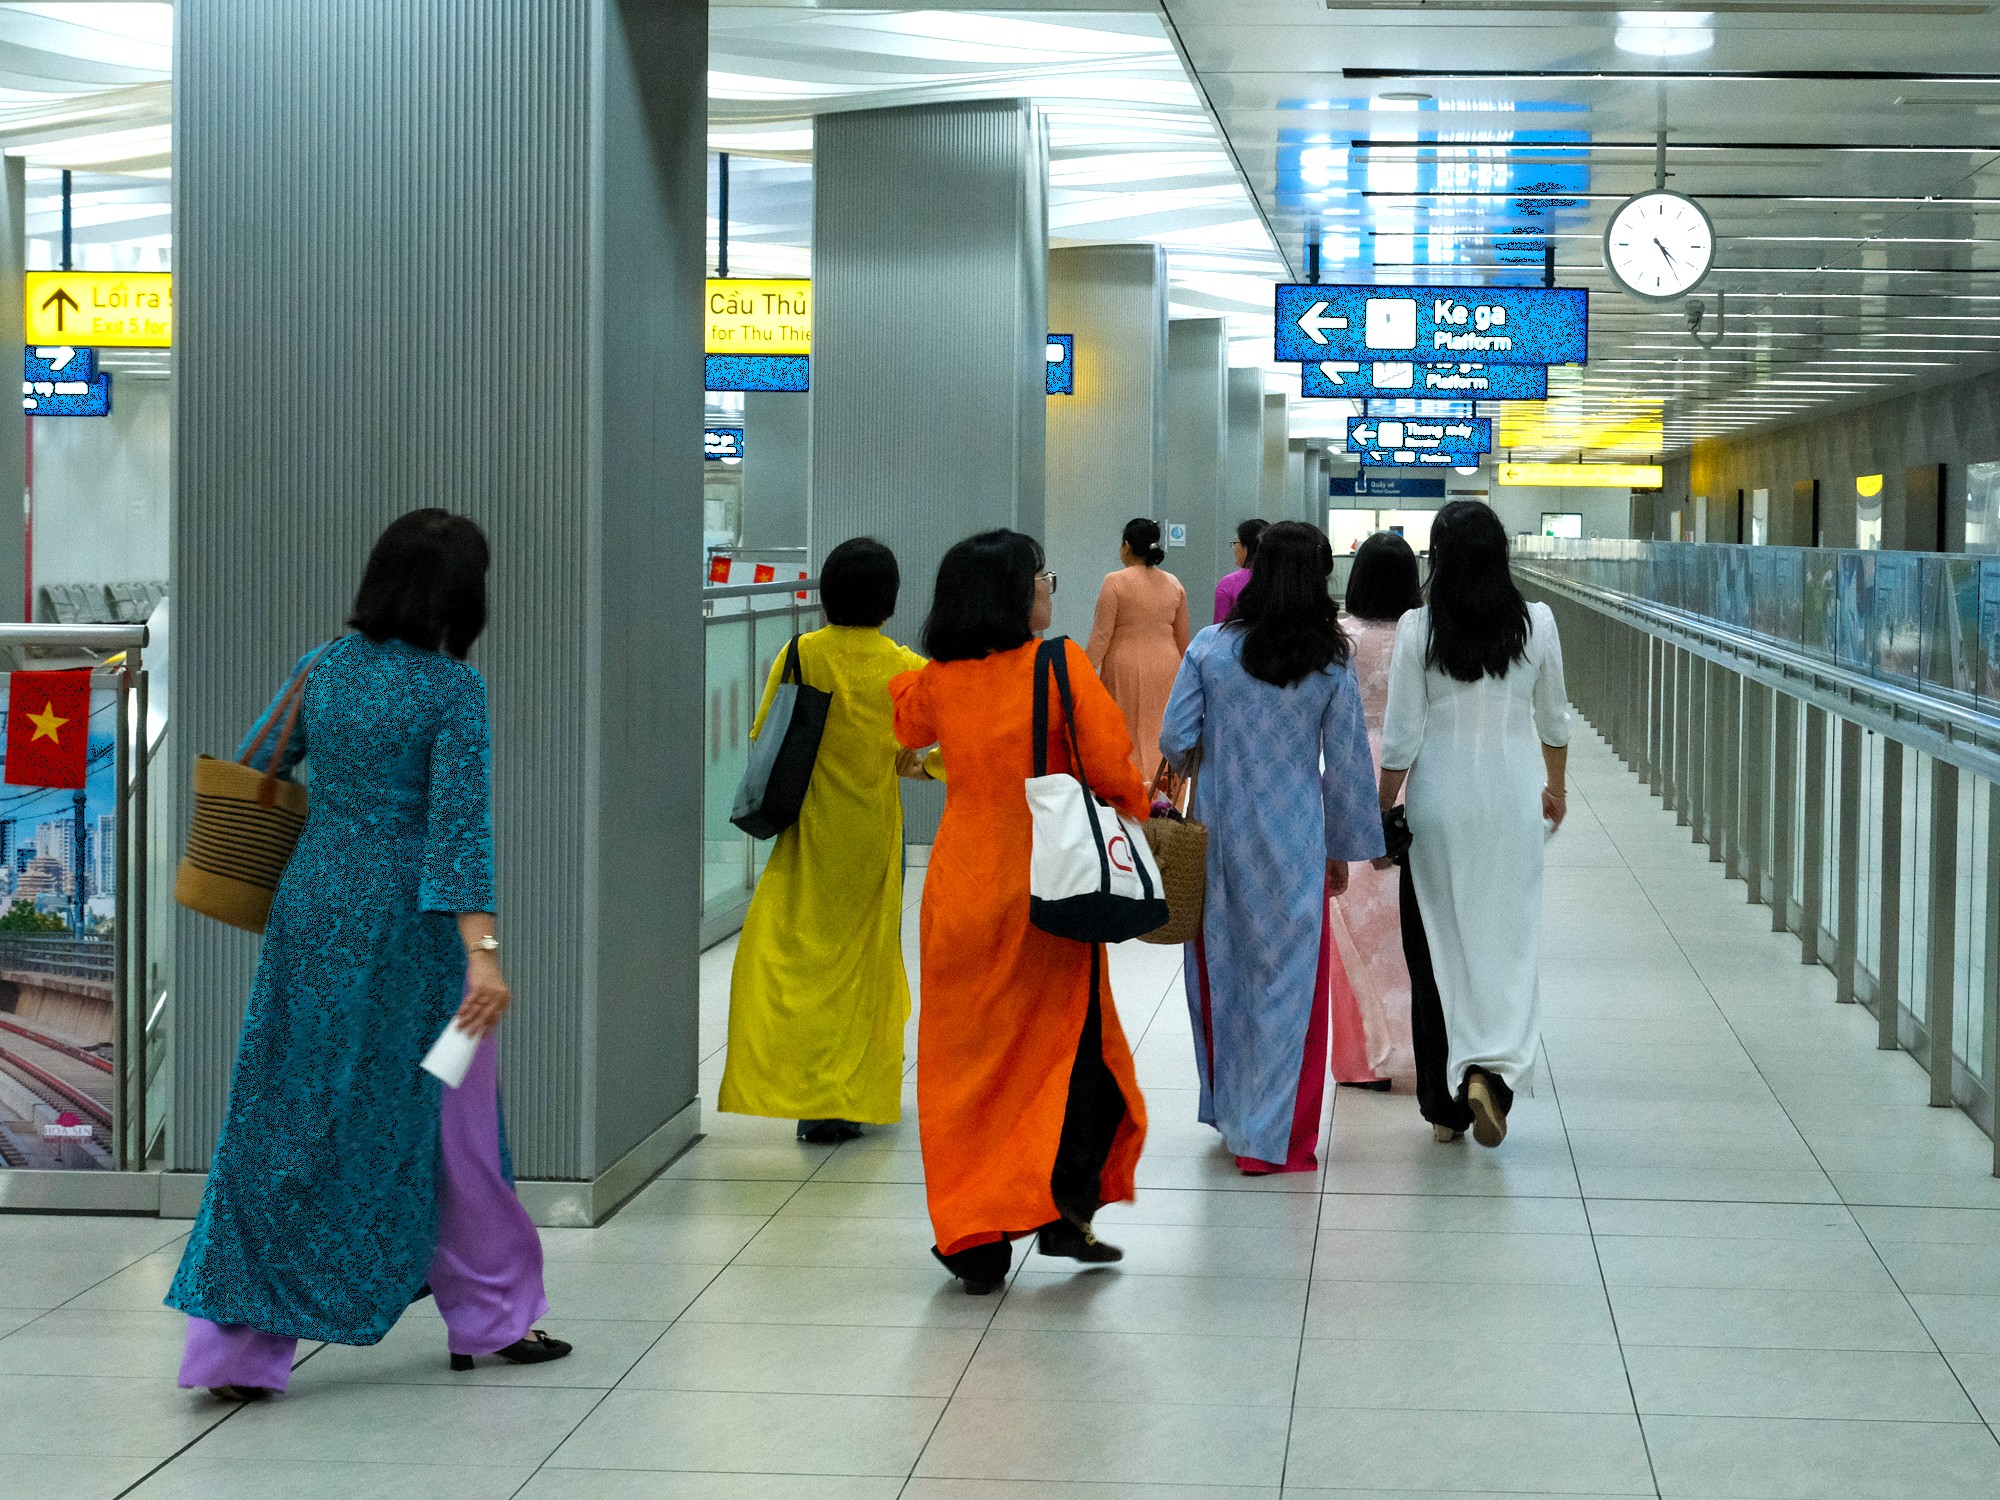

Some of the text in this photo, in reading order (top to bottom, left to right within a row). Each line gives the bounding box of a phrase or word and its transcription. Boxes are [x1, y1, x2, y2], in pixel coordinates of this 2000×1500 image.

[92, 282, 128, 308] Lối
[136, 292, 160, 308] ra
[710, 290, 806, 315] Cầu Thủ
[1434, 299, 1506, 331] Ke ga
[92, 317, 168, 335] Exit 5 for
[712, 325, 735, 341] for
[741, 325, 772, 341] Thu
[1434, 331, 1512, 351] Platform
[1426, 373, 1489, 390] Platform
